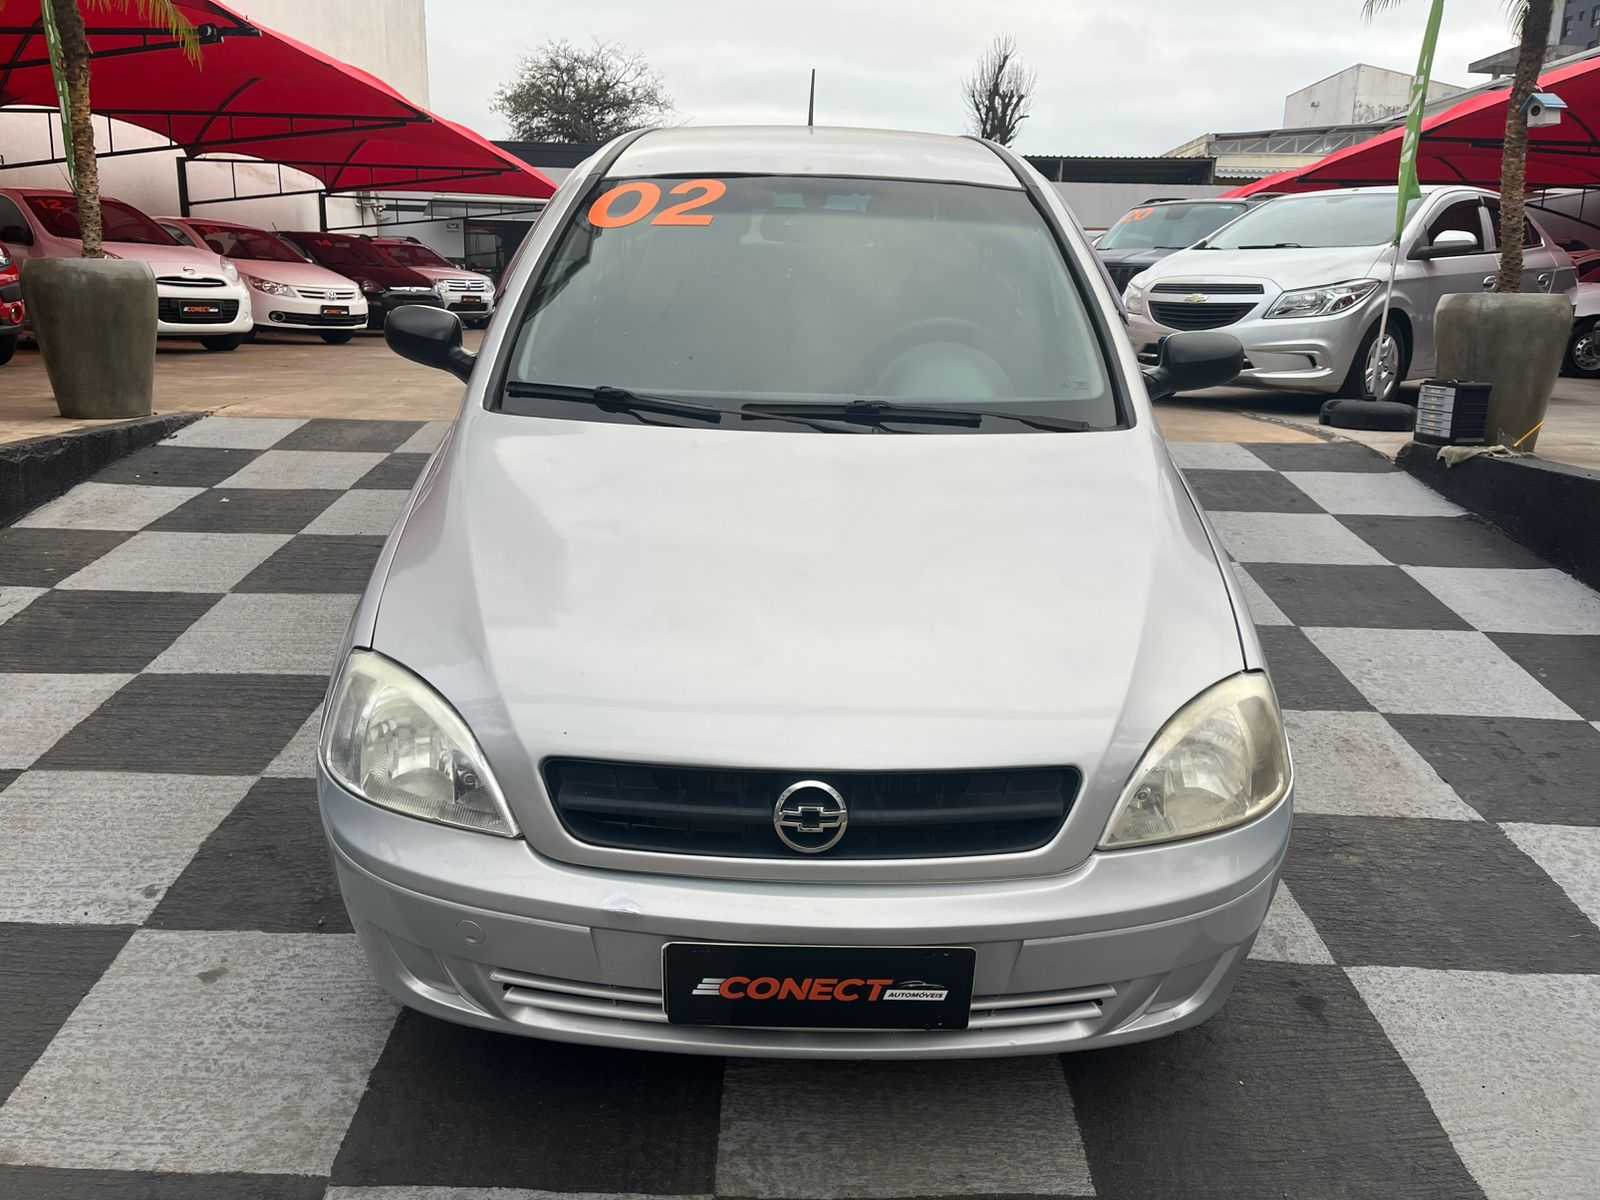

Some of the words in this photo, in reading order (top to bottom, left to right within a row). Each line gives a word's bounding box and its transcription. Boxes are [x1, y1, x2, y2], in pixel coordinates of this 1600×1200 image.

[588, 180, 726, 228] 02
[719, 976, 893, 1001] CONECT
[888, 992, 945, 1000] AUTOMÓVEIS
